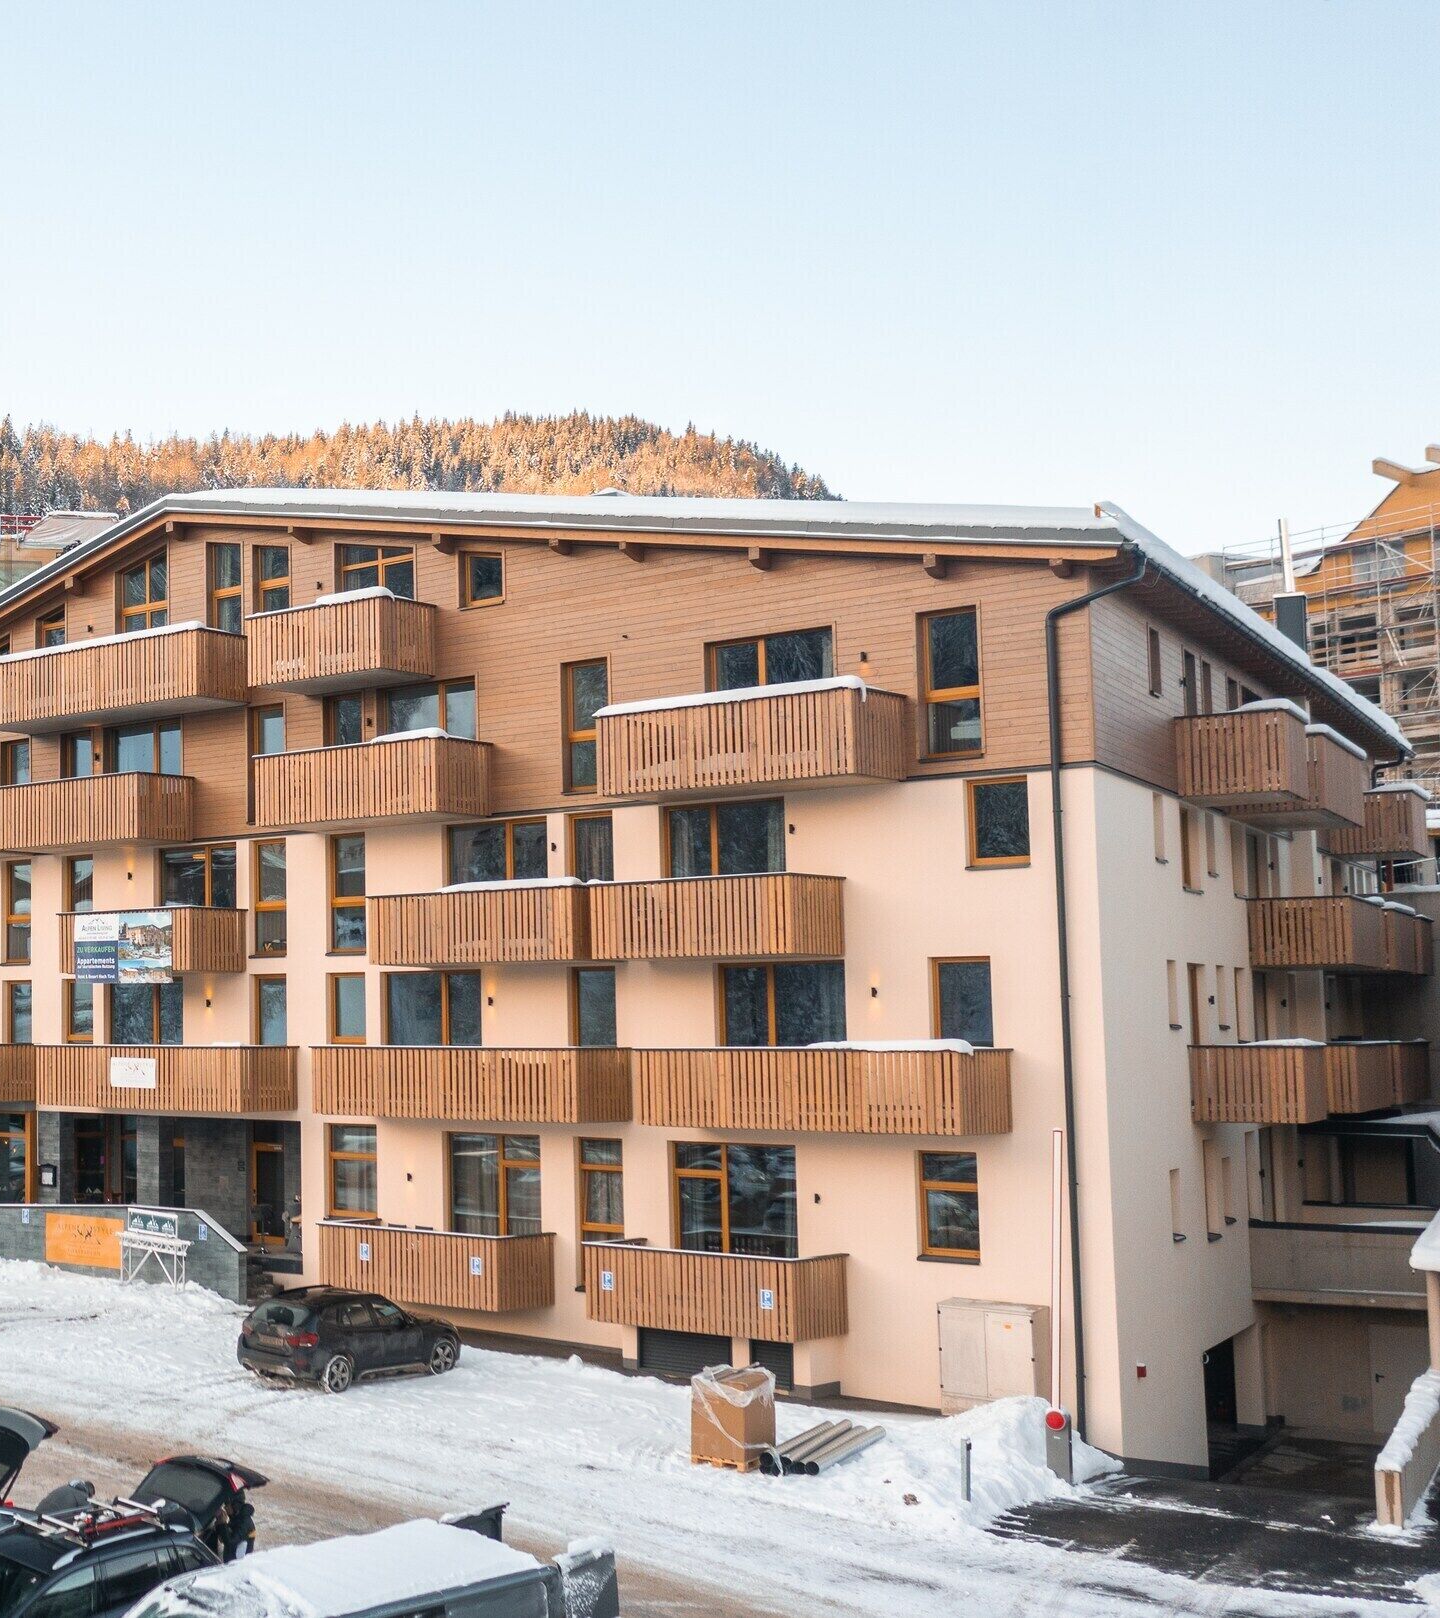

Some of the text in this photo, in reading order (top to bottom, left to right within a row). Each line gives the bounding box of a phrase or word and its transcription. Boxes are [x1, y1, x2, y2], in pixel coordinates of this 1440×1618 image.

[76, 945, 116, 954] ZU VERKAUFEN
[76, 957, 115, 966] Appartements
